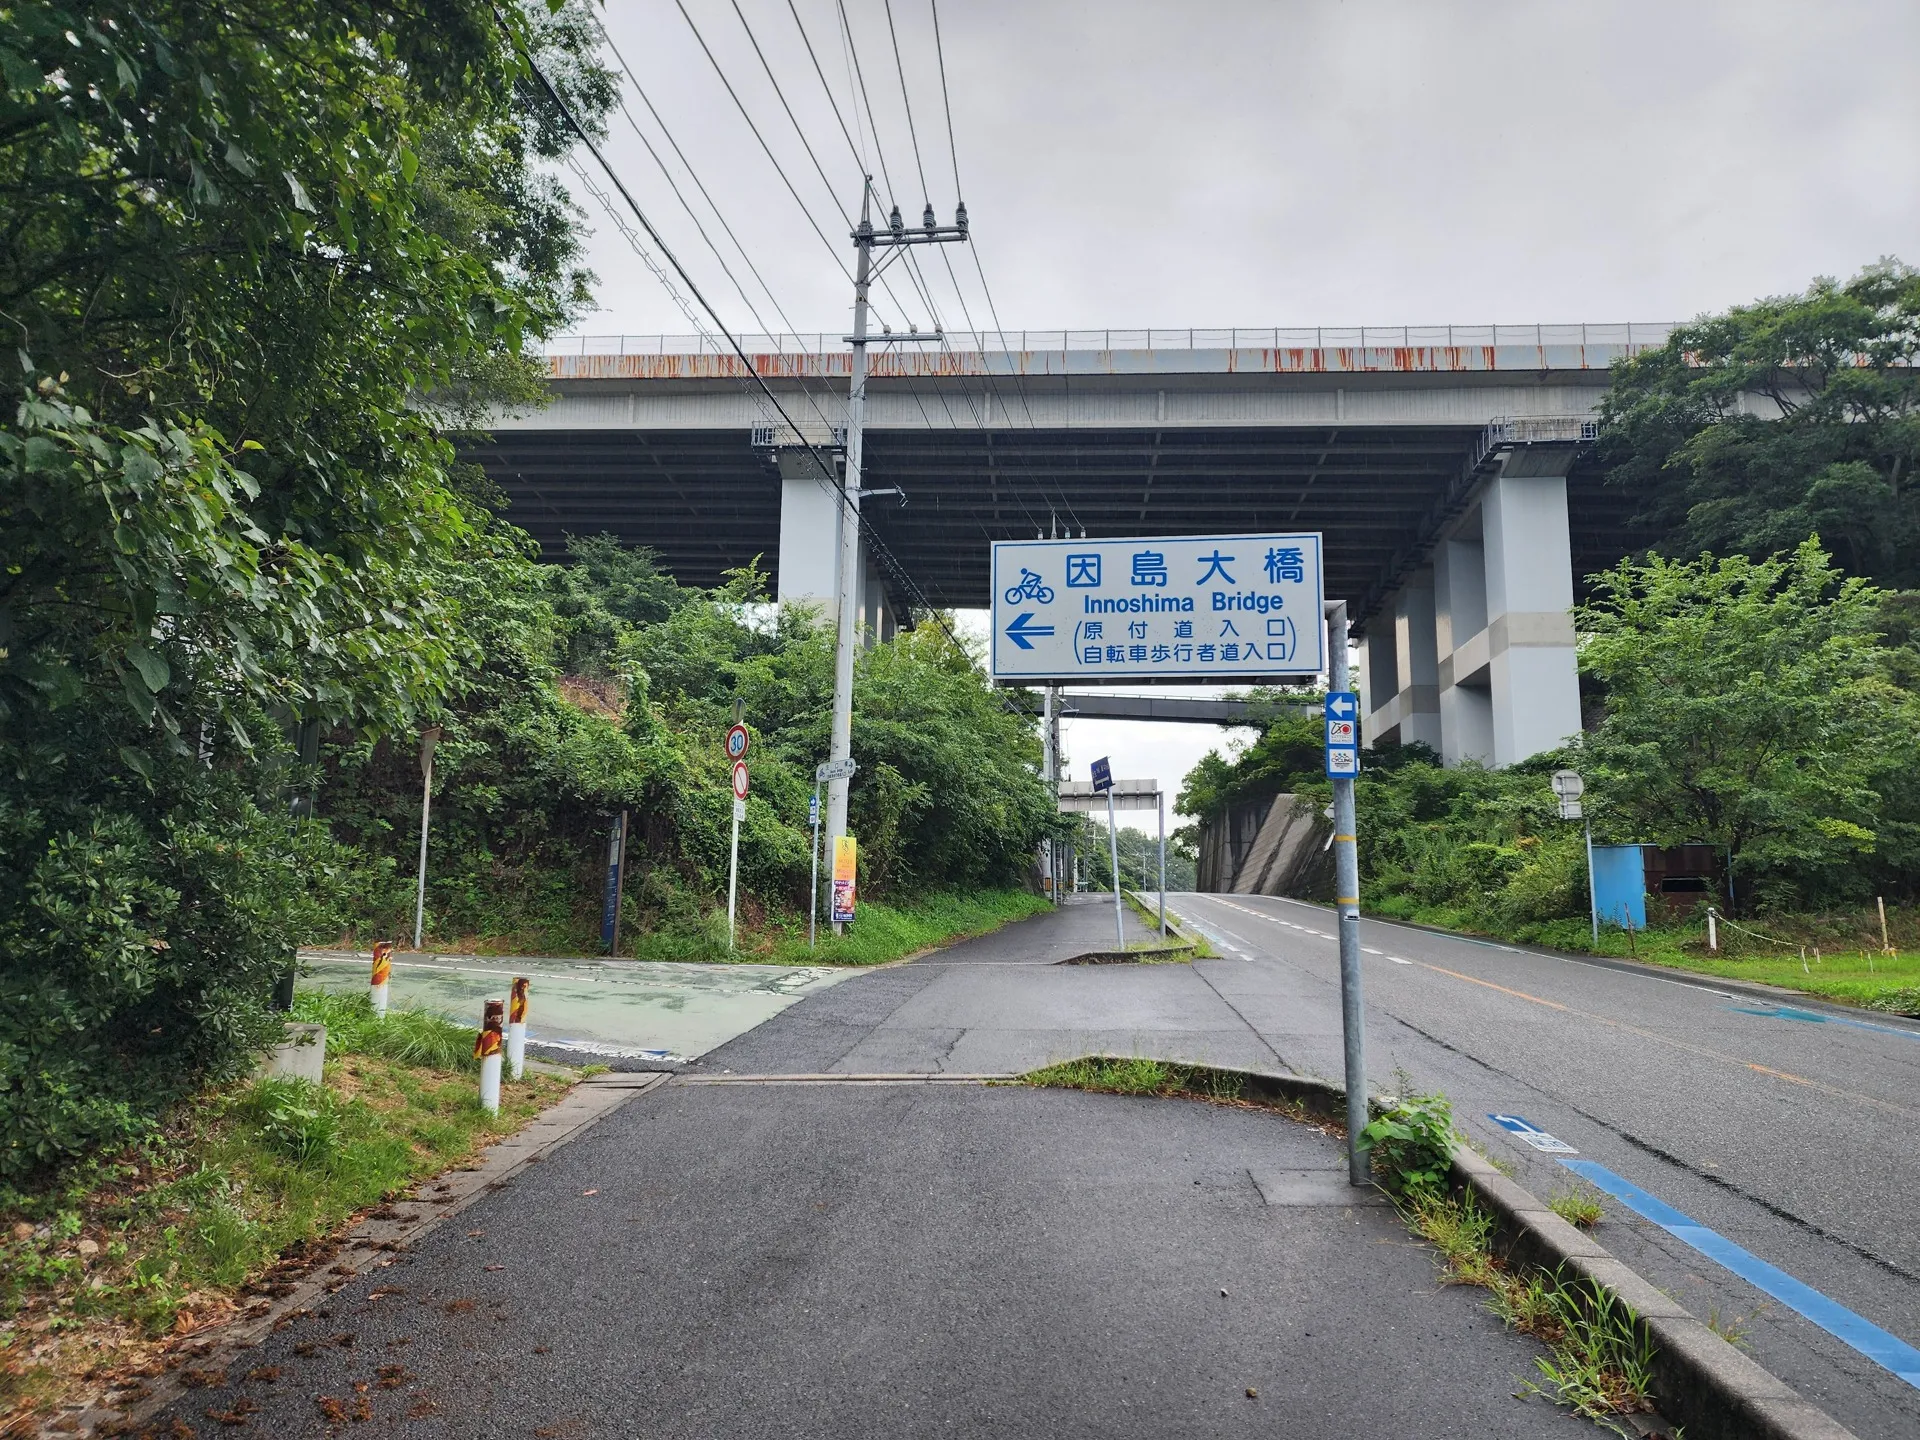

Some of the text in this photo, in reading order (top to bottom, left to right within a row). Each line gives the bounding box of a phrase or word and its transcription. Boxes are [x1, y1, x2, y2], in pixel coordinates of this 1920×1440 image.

[1066, 547, 1304, 588] 因島大橋
[1084, 592, 1283, 614] Innoshima Bridge
[731, 735, 744, 752] 30
